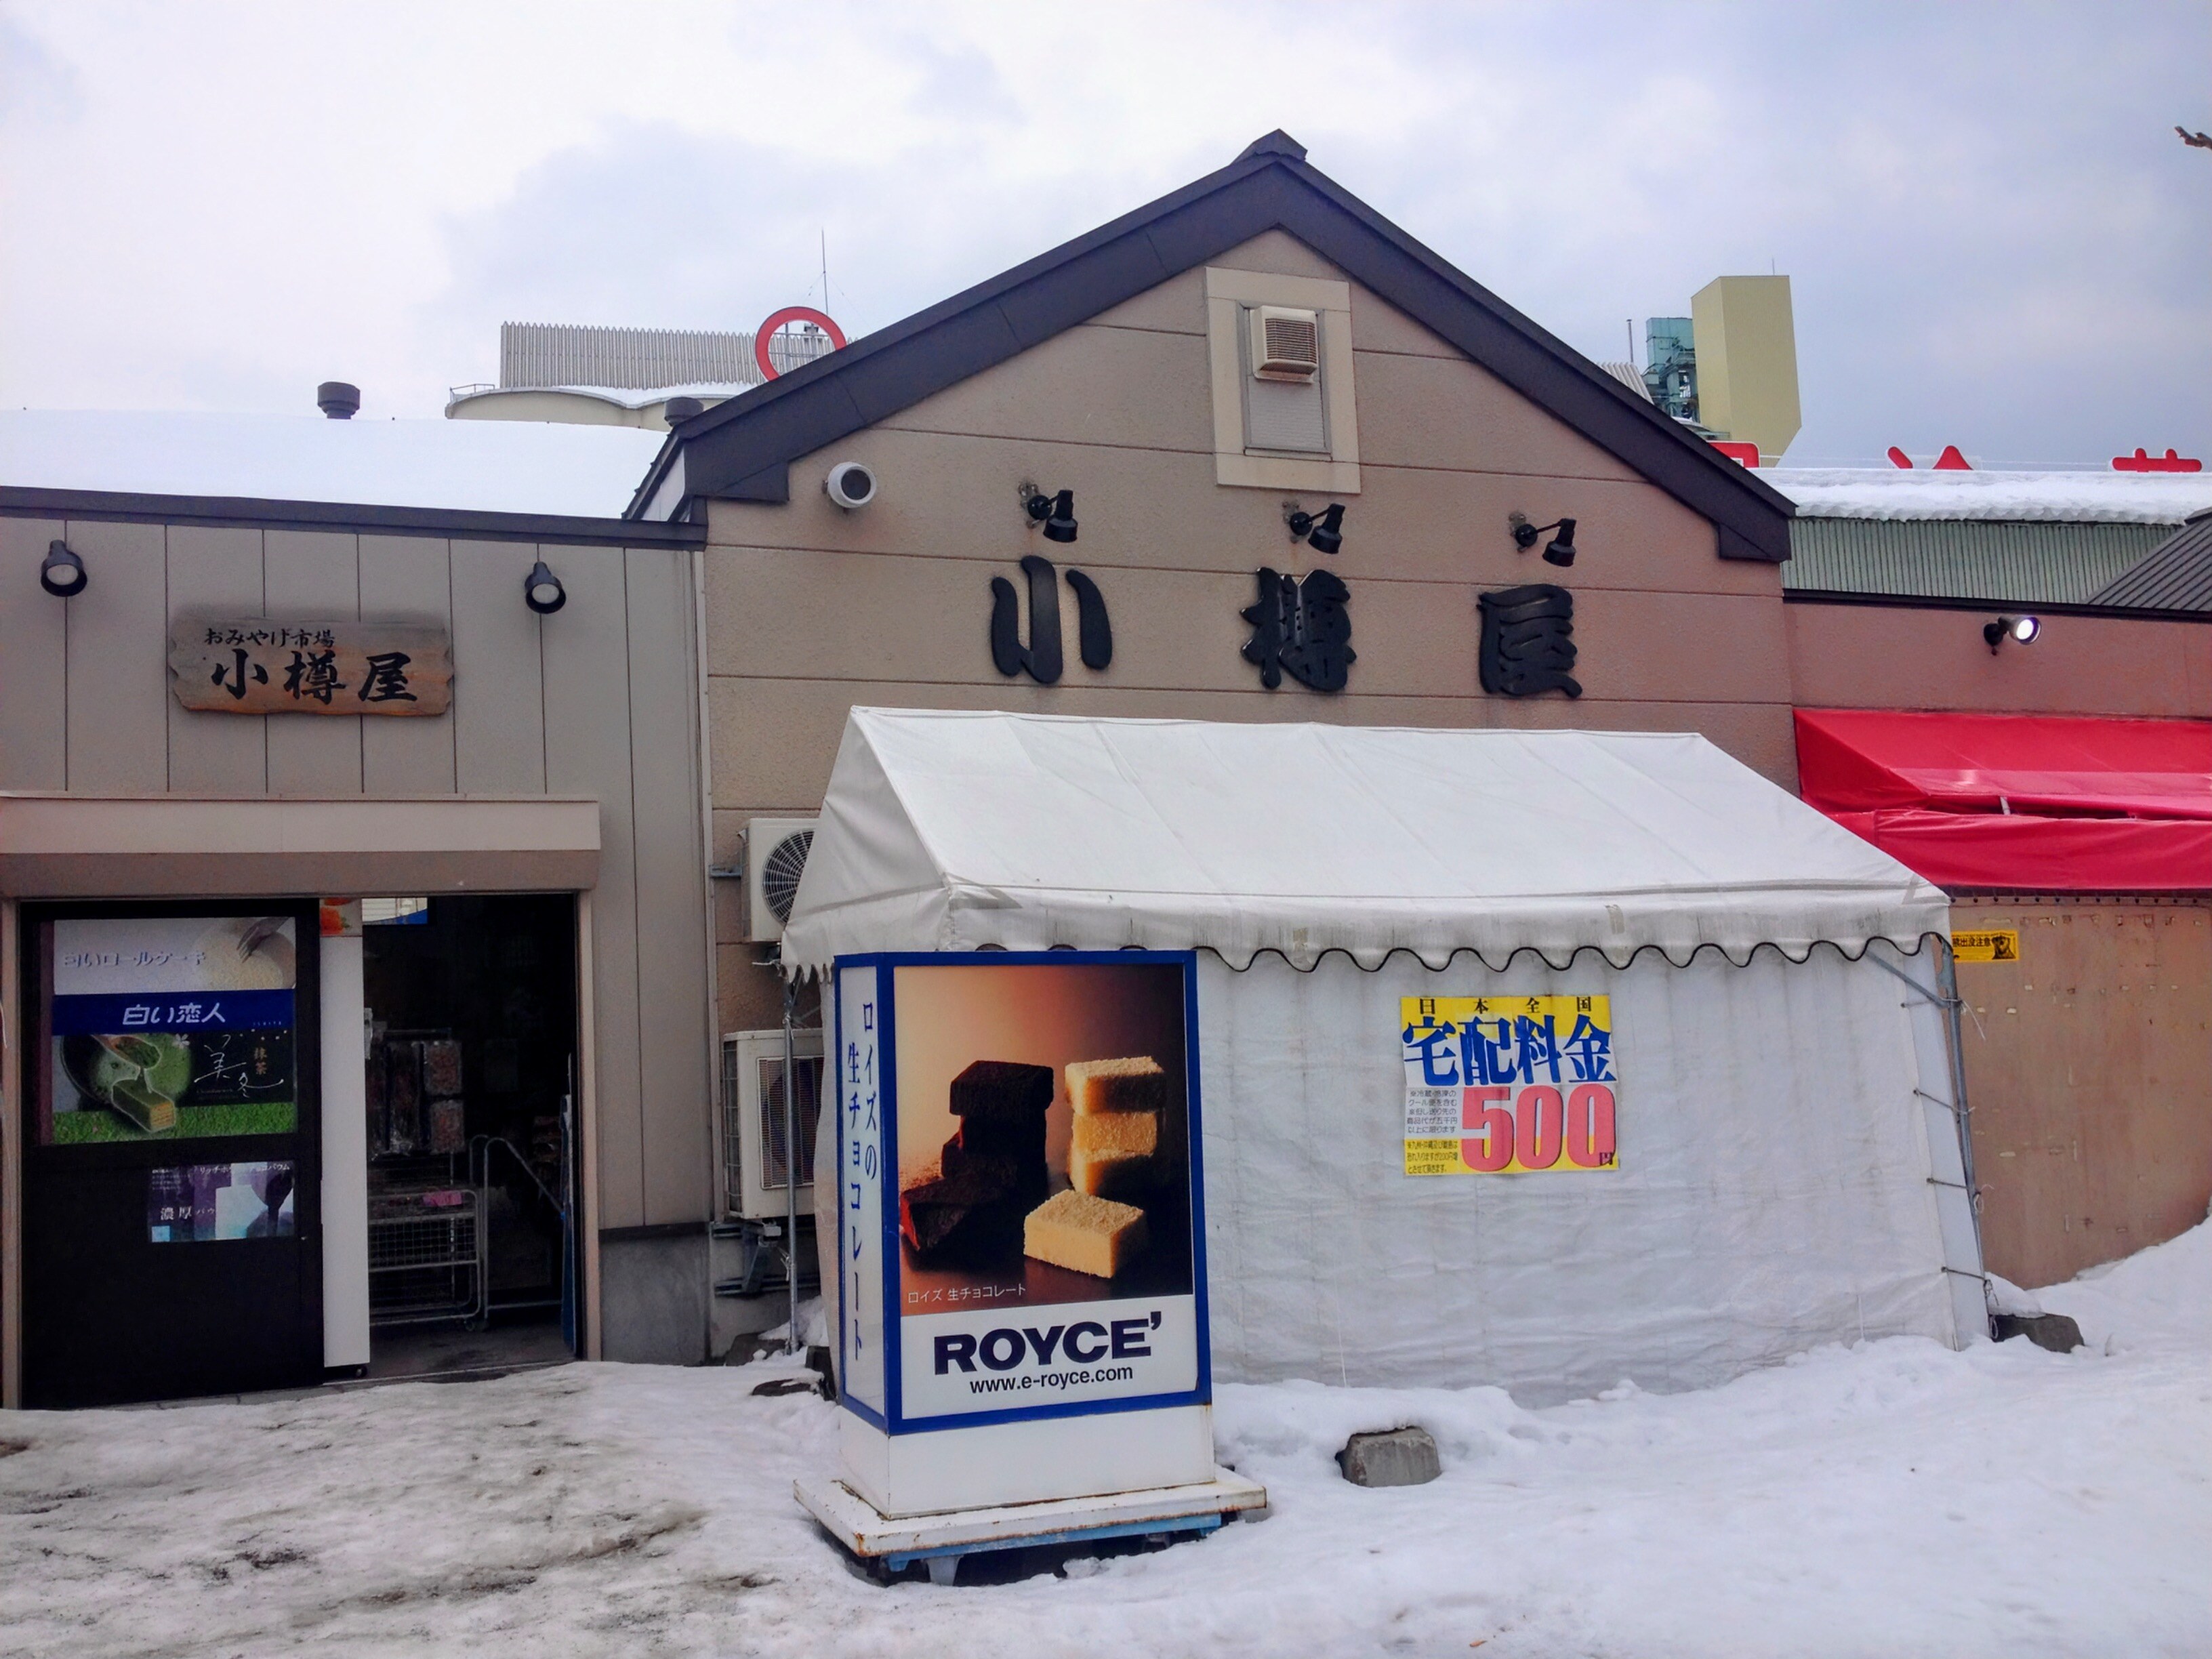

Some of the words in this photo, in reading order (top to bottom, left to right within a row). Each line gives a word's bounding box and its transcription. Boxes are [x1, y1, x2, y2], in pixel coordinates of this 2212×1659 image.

[204, 628, 335, 648] おみやげ市場
[990, 554, 1583, 699] 小樽屋
[211, 648, 417, 705] 小樽屋
[122, 1002, 226, 1025] 白い恋人
[1419, 996, 1592, 1015] 日本全国
[1402, 1014, 1617, 1086] 宅配料金
[862, 1002, 878, 1181] ロイズの
[847, 1042, 863, 1361] 生チョコレート
[907, 1288, 943, 1304] ロイズ
[947, 1284, 1026, 1303] 生チョコレート
[970, 1366, 1133, 1394] www.e-royce.com
